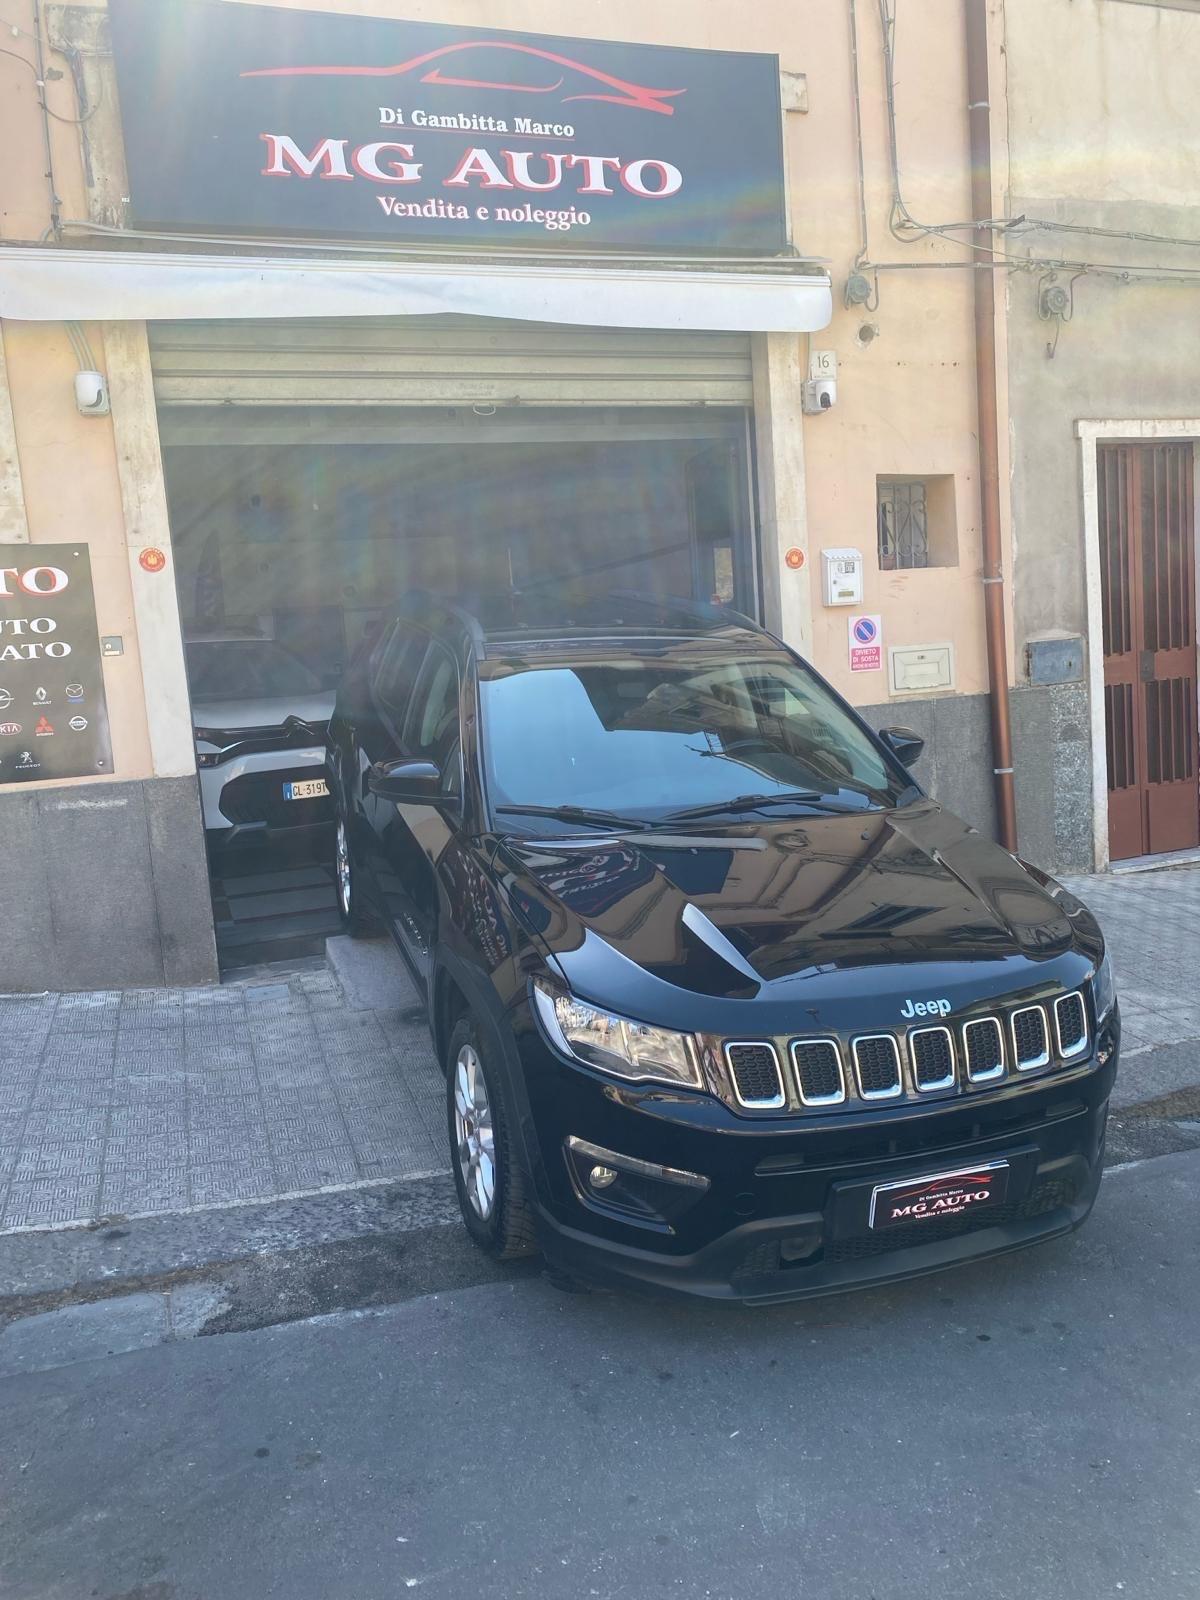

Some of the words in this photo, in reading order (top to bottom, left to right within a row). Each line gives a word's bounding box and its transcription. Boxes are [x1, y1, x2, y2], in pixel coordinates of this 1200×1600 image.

[379, 107, 403, 125] Di
[411, 110, 508, 132] Gambitta
[515, 117, 575, 137] Marco
[259, 133, 423, 185] MG
[443, 148, 682, 198] AUTO
[377, 196, 470, 220] Vendita
[477, 208, 489, 221] e
[496, 204, 591, 230] noleggio
[817, 354, 830, 369] 16
[900, 999, 952, 1018] Jeep
[891, 1203, 927, 1218] MG
[931, 1191, 990, 1210] AUTO
